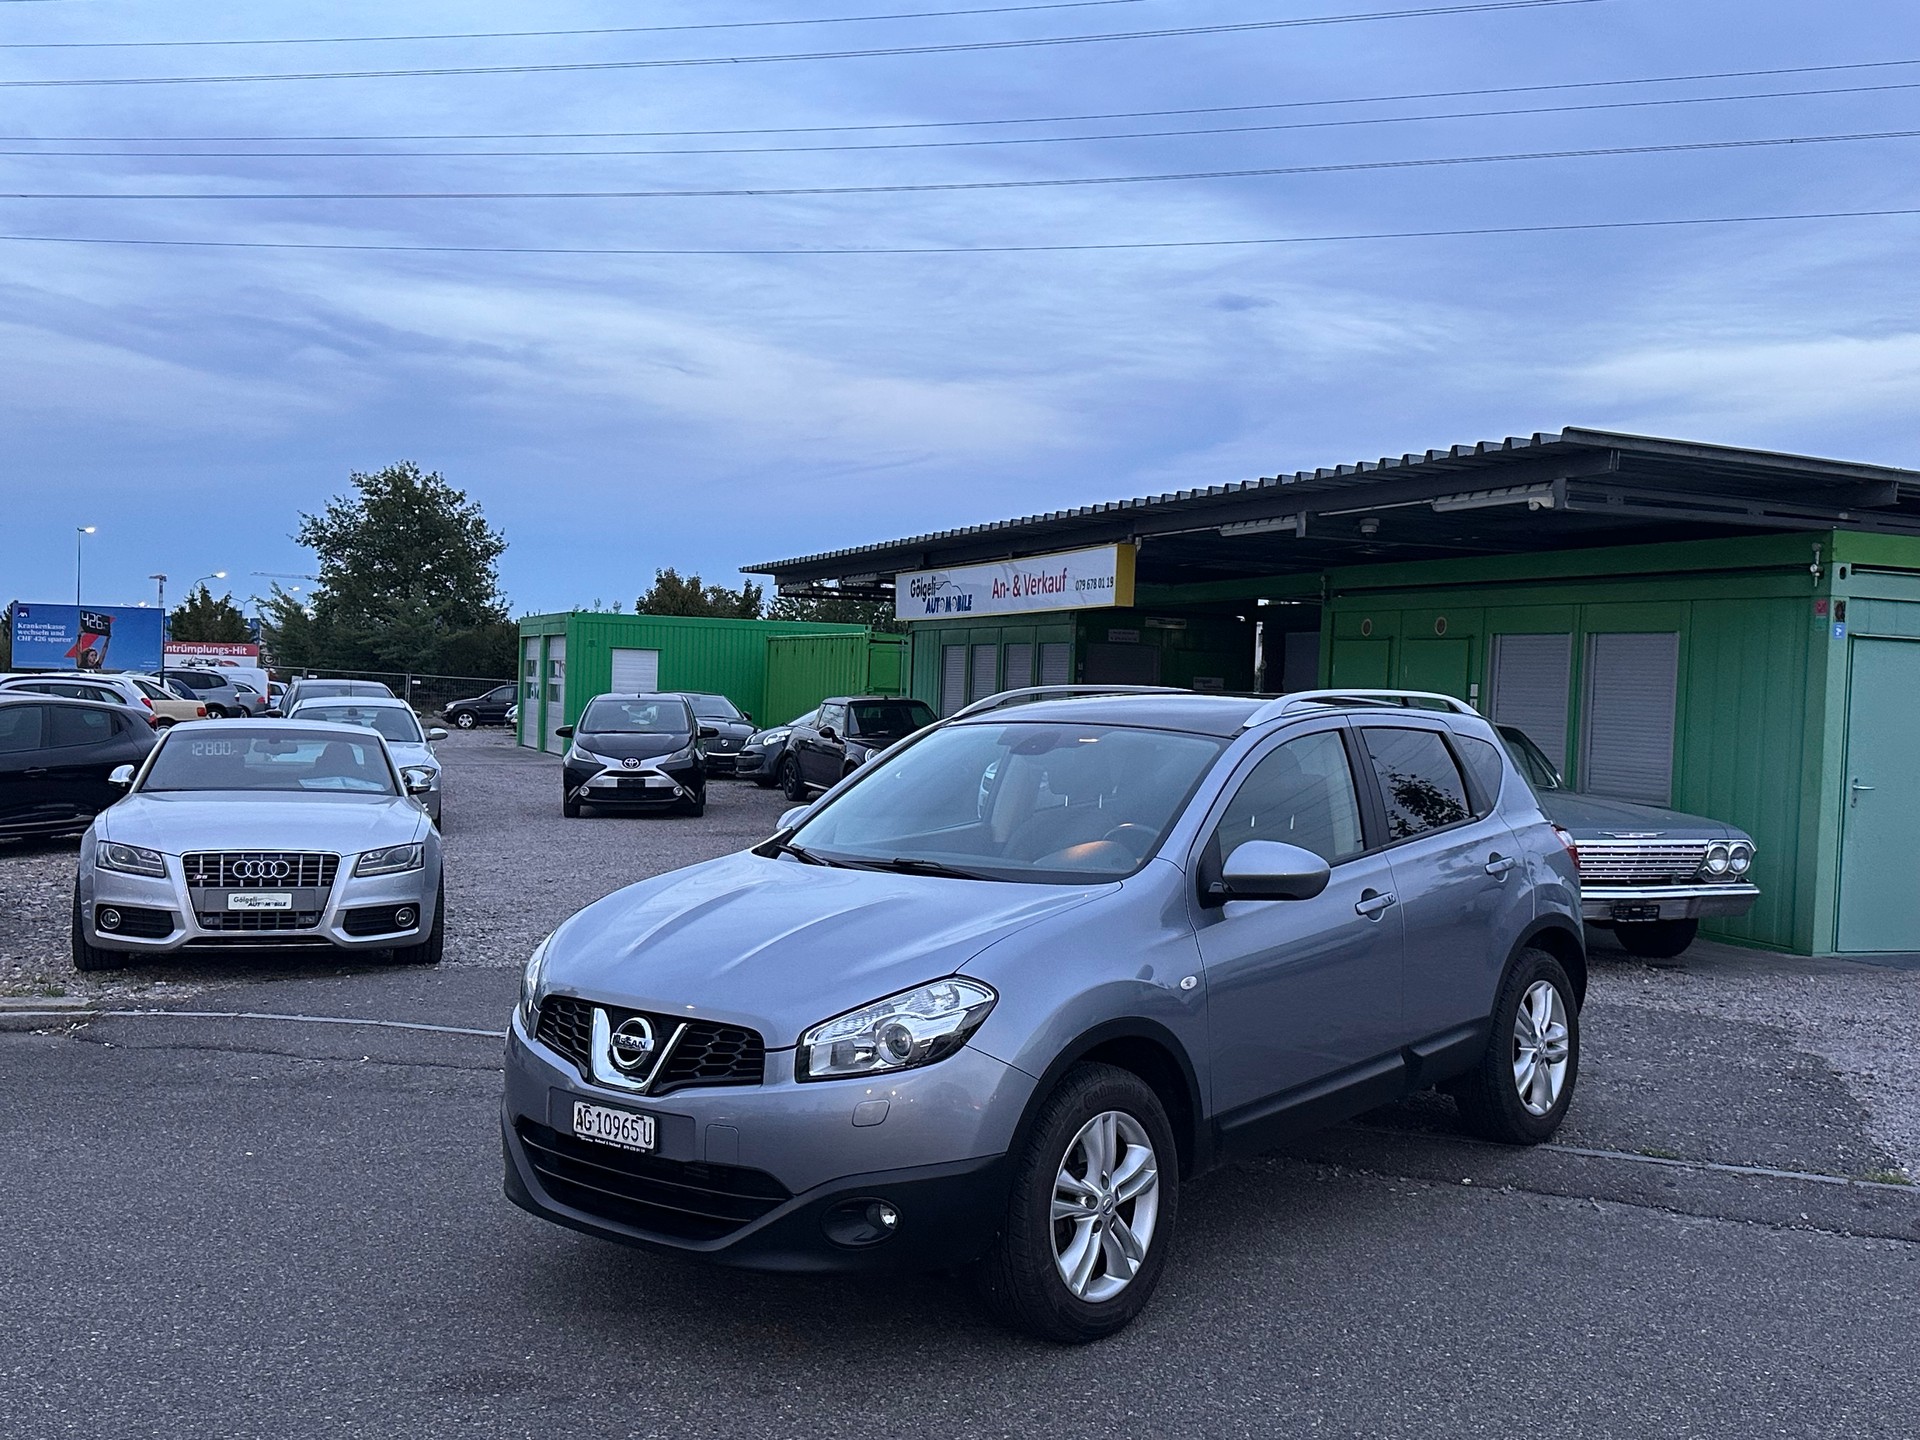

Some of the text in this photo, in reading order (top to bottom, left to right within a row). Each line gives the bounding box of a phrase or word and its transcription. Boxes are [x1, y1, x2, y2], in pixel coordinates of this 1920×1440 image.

[910, 576, 937, 602] Gölgeli
[992, 567, 1068, 599] An- & Verkauf
[1075, 576, 1114, 592] 079 678 01 19
[17, 622, 66, 630] Krankenkasse
[17, 629, 49, 637] wechseln
